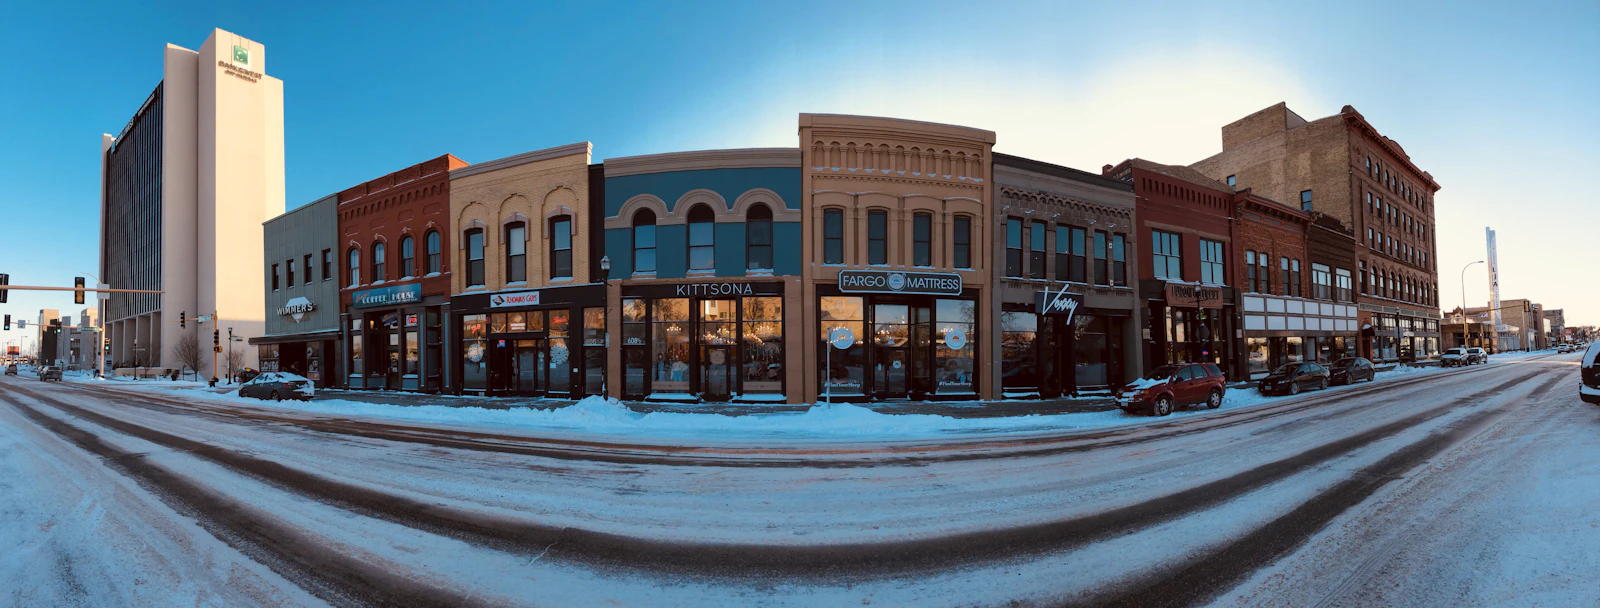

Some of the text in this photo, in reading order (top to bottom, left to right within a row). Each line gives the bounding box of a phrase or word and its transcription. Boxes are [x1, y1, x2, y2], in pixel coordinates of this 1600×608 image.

[843, 275, 959, 290] FARGO MATTRESS
[676, 283, 753, 295] KITTSONA
[362, 294, 387, 304] COFFEE
[392, 291, 415, 301] HOUSE
[506, 295, 525, 303] RHOMBUS
